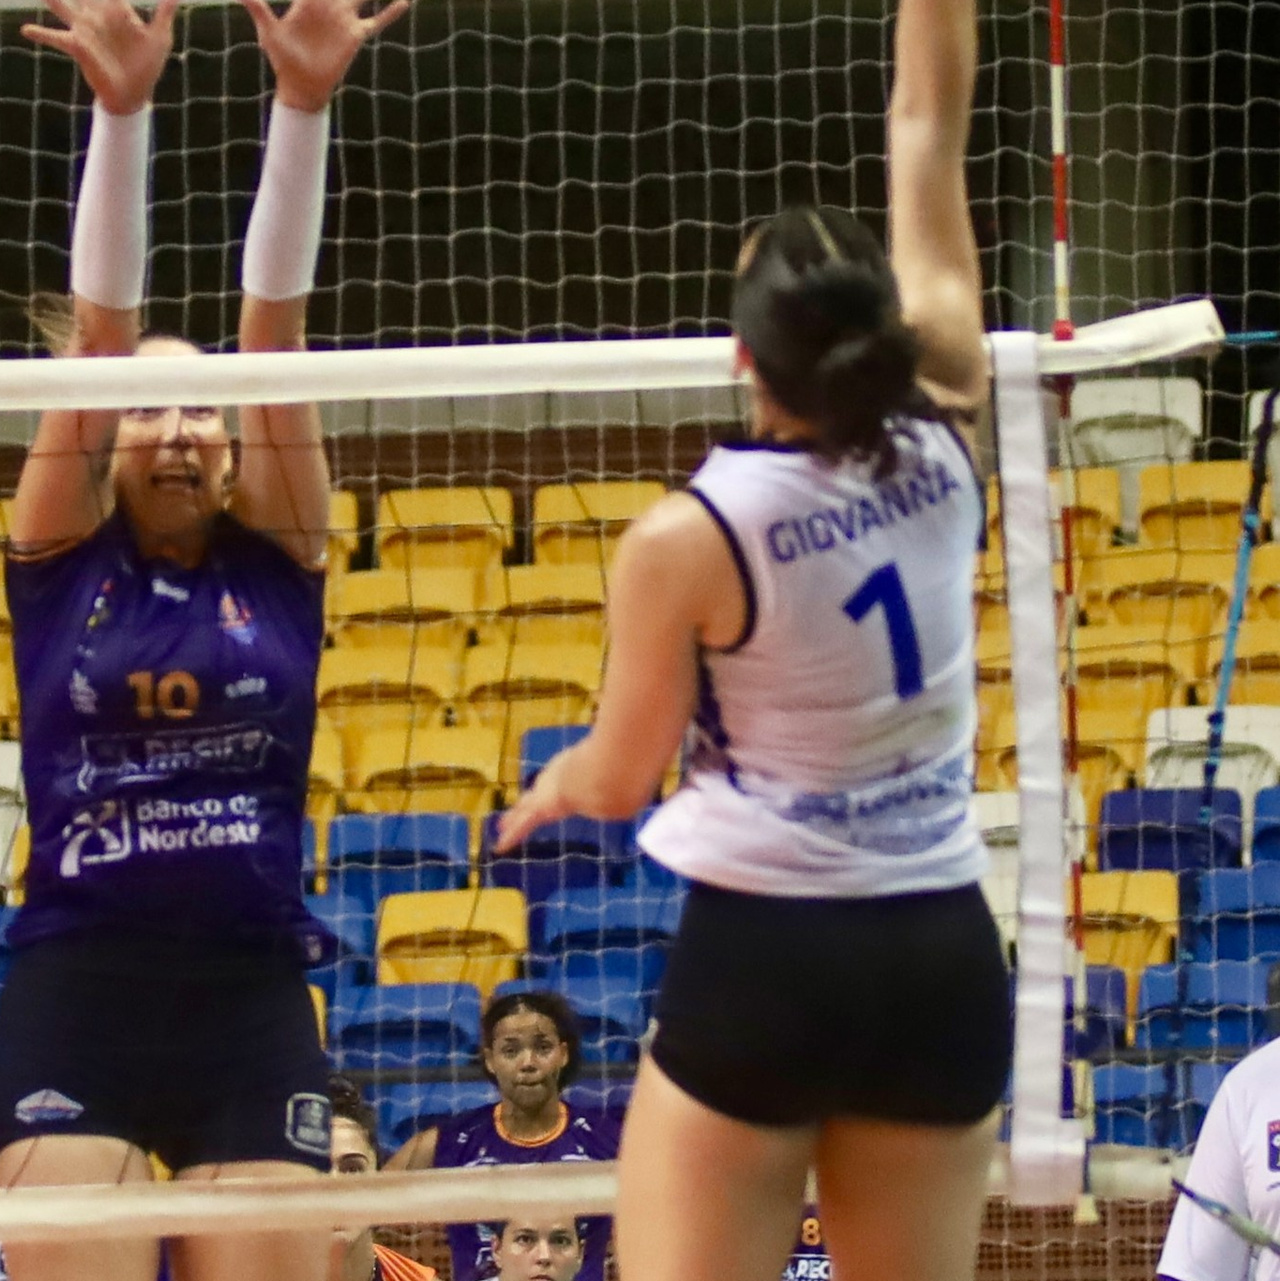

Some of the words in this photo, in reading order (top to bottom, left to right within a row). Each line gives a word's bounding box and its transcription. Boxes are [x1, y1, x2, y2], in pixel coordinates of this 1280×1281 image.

[765, 461, 958, 563] GIOVANNA
[843, 559, 924, 701] 1
[126, 671, 200, 718] 10
